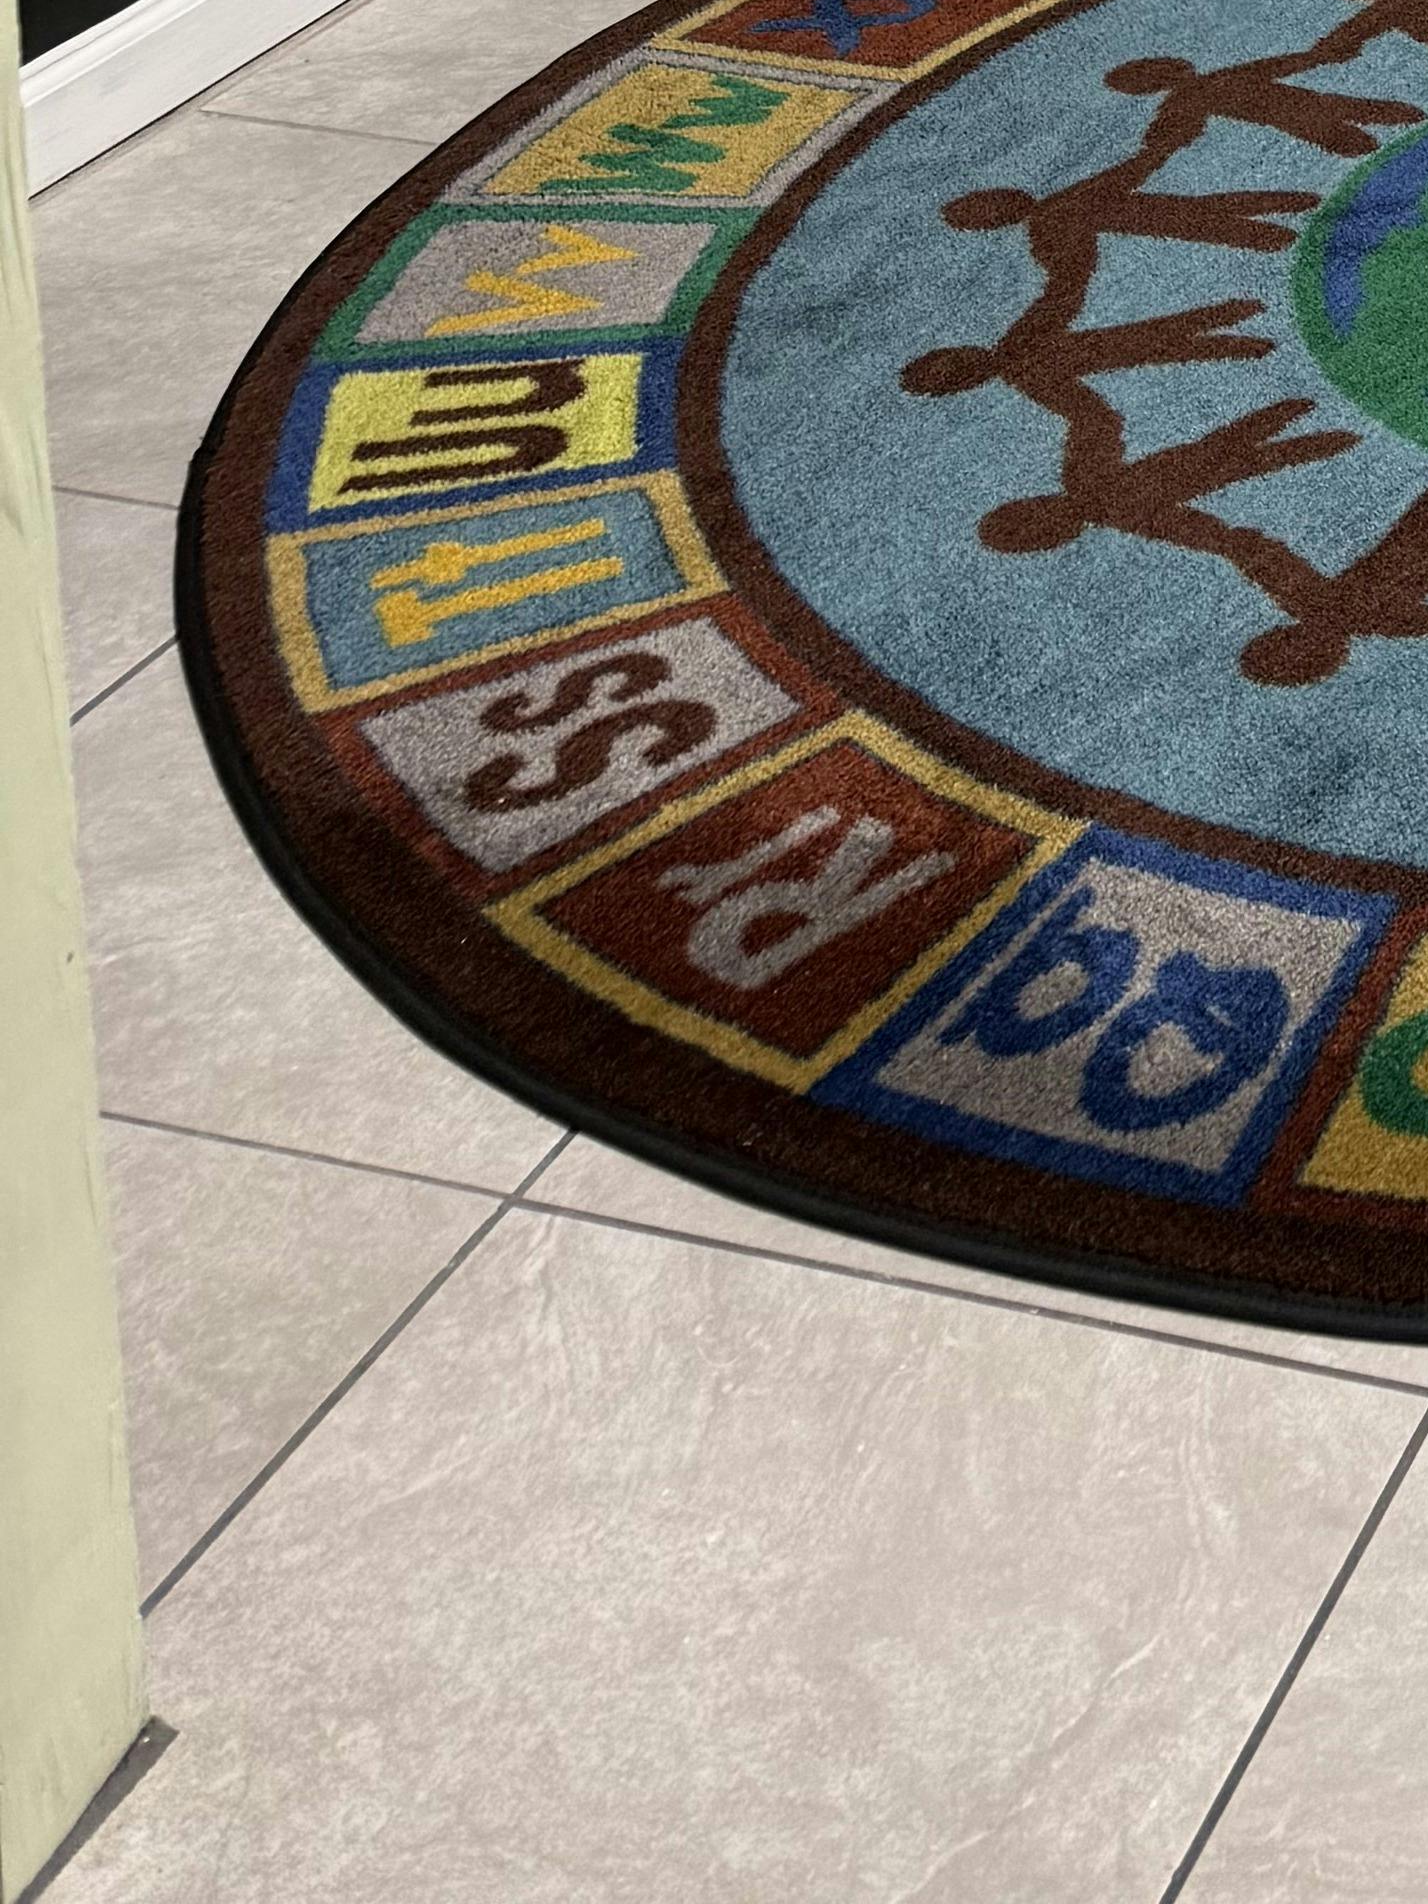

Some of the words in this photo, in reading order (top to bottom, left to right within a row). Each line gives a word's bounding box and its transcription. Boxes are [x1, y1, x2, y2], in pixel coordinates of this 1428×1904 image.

[537, 75, 794, 194] Ww
[424, 225, 638, 337] Vv
[341, 359, 586, 494] Uu
[369, 518, 625, 648] Tt
[462, 650, 723, 816] Ss
[653, 806, 955, 990] Rr
[939, 886, 1295, 1132] Qq
